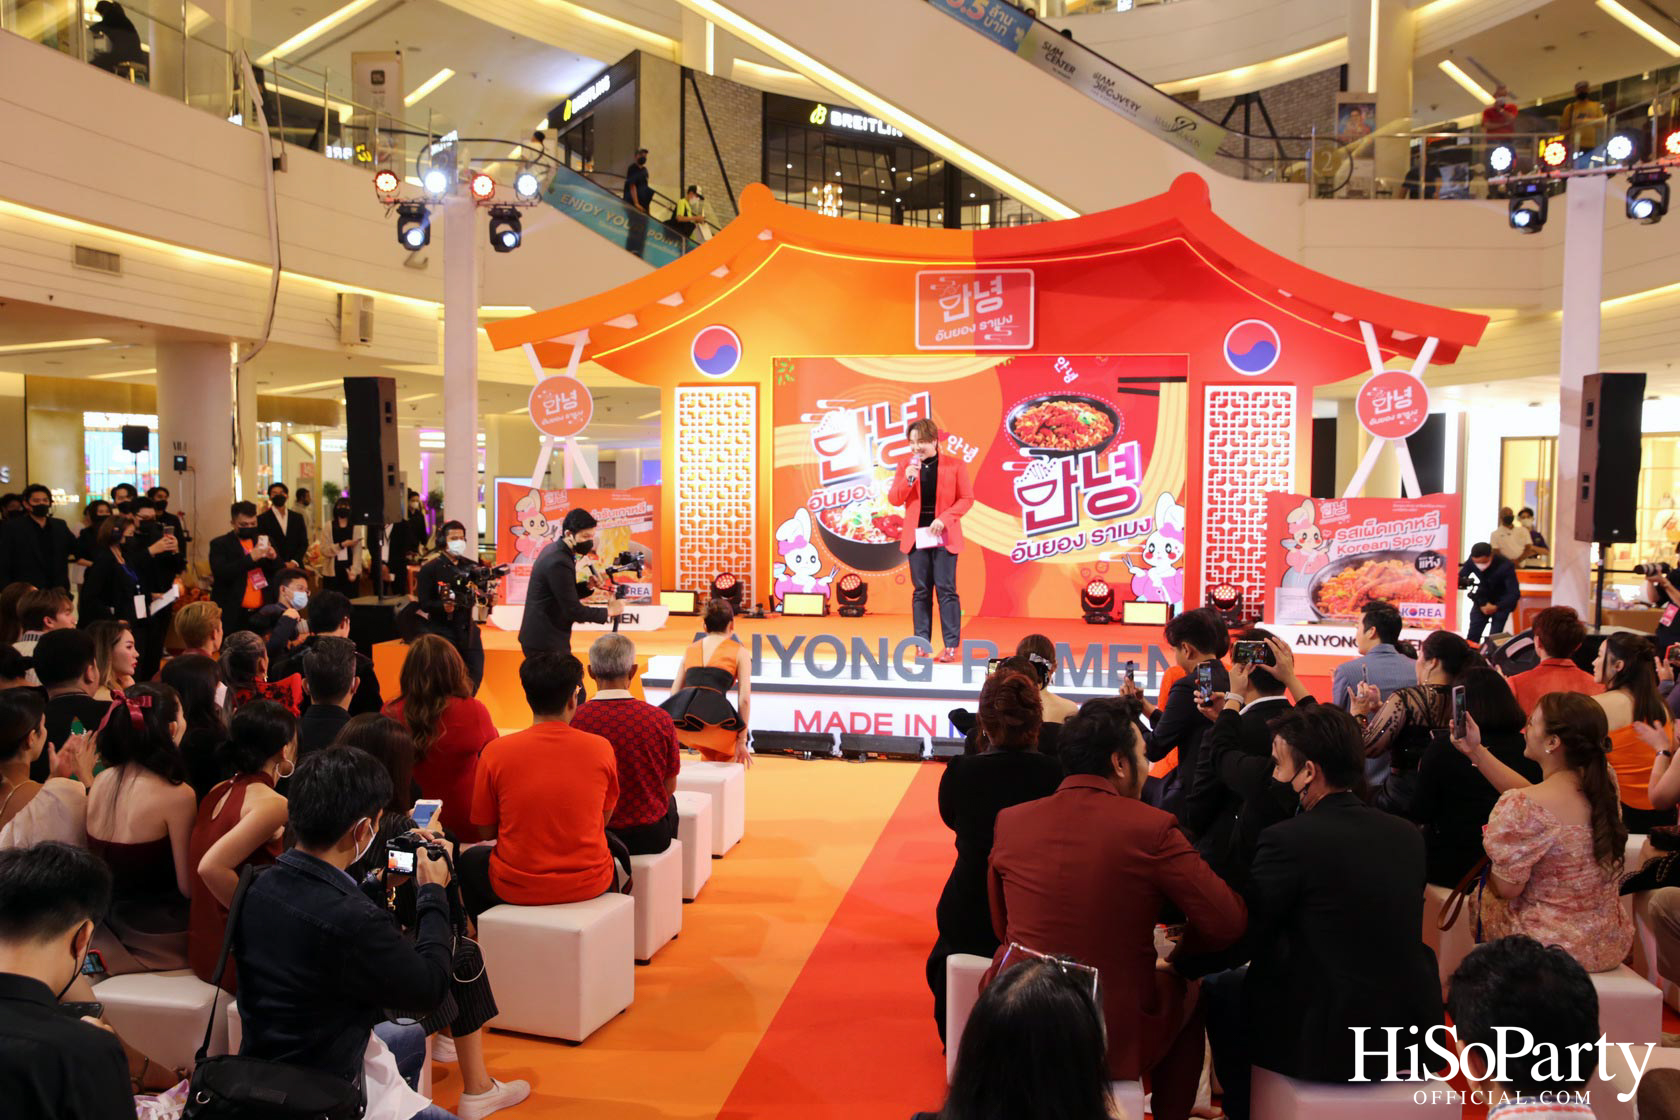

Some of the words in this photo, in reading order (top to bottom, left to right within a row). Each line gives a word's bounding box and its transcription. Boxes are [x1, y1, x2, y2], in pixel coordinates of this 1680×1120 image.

[1042, 41, 1064, 58] SIAM
[1045, 53, 1076, 75] CENTER
[560, 193, 602, 217] ENJOY
[1015, 441, 1141, 534] 안녕
[1010, 531, 1086, 563] อันยอง
[1090, 516, 1153, 545] ราเมง
[1336, 541, 1389, 555] Korean
[1392, 534, 1434, 548] Spicy
[794, 709, 893, 736] MADE
[904, 714, 937, 738] IN
